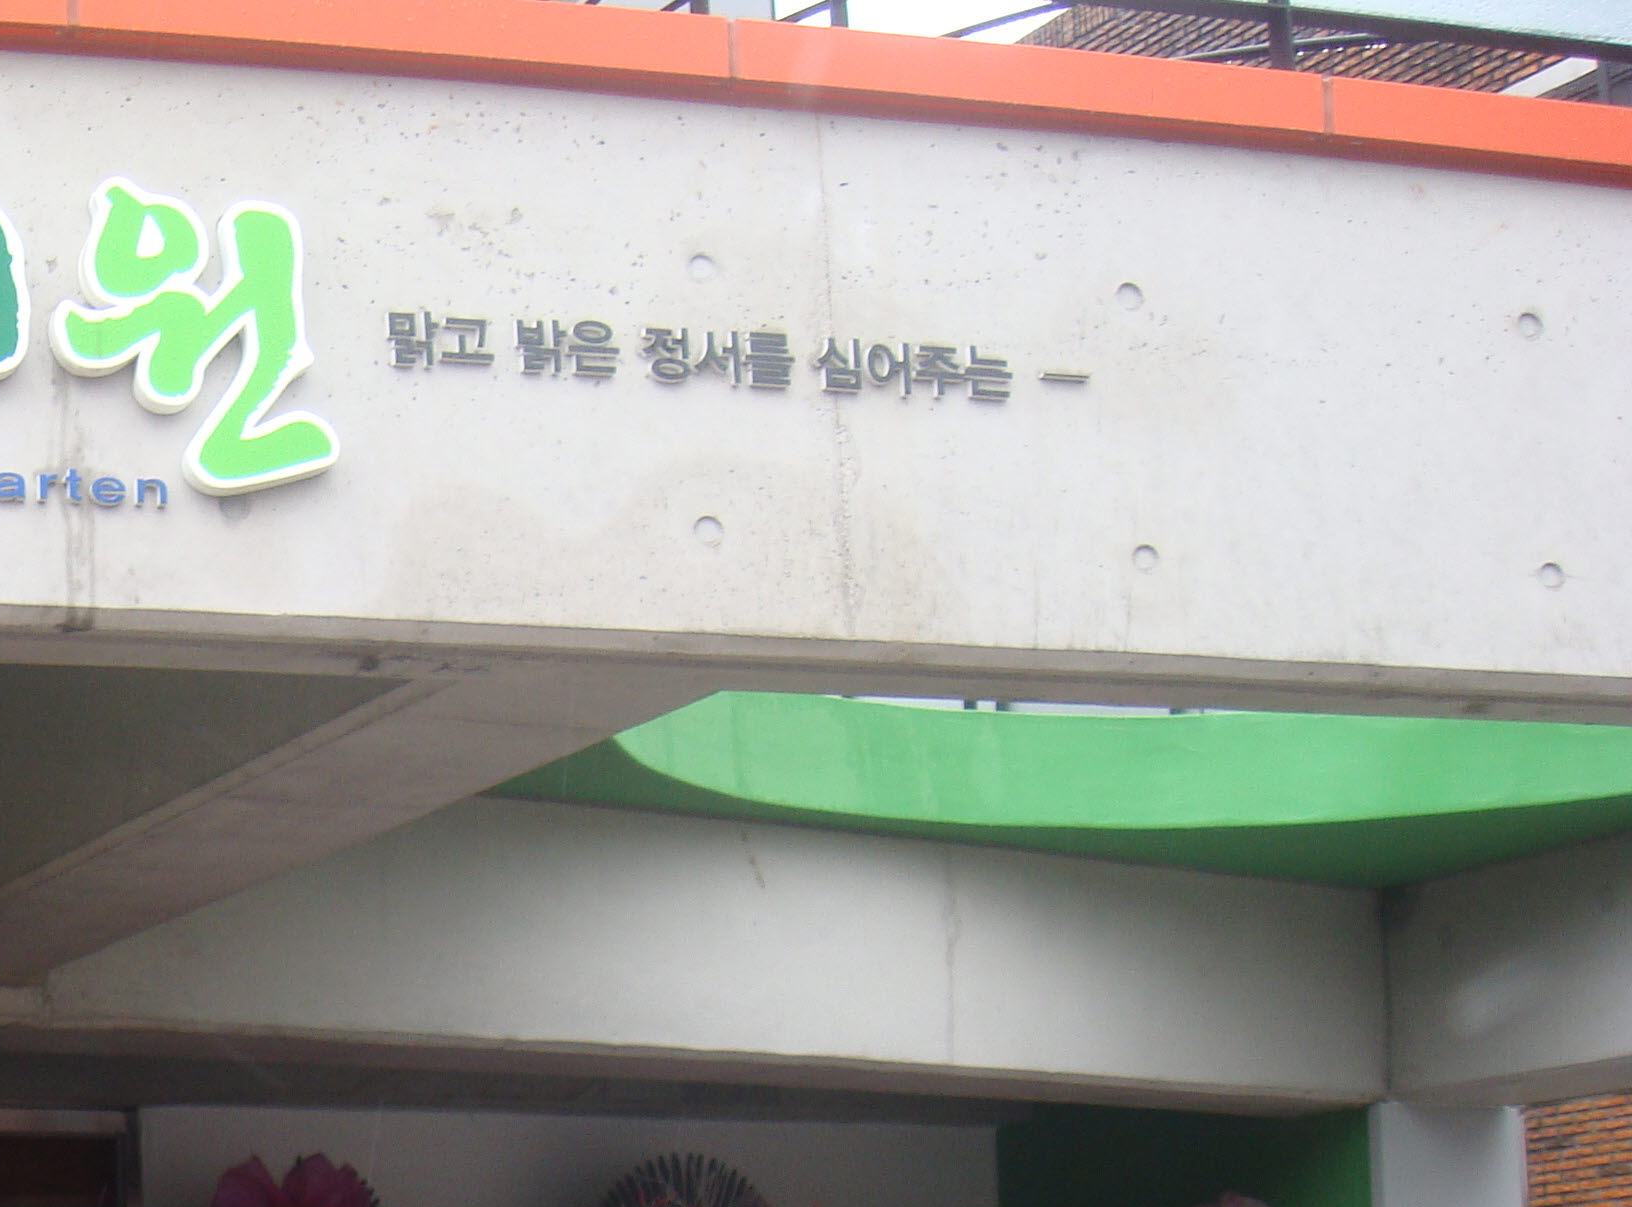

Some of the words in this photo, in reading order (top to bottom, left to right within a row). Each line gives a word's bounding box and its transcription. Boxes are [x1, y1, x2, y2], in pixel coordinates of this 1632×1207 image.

[385, 310, 496, 369] 맑고
[513, 318, 620, 378] 밝은
[641, 327, 796, 390] 정서를
[817, 336, 1014, 402] 심어주는
